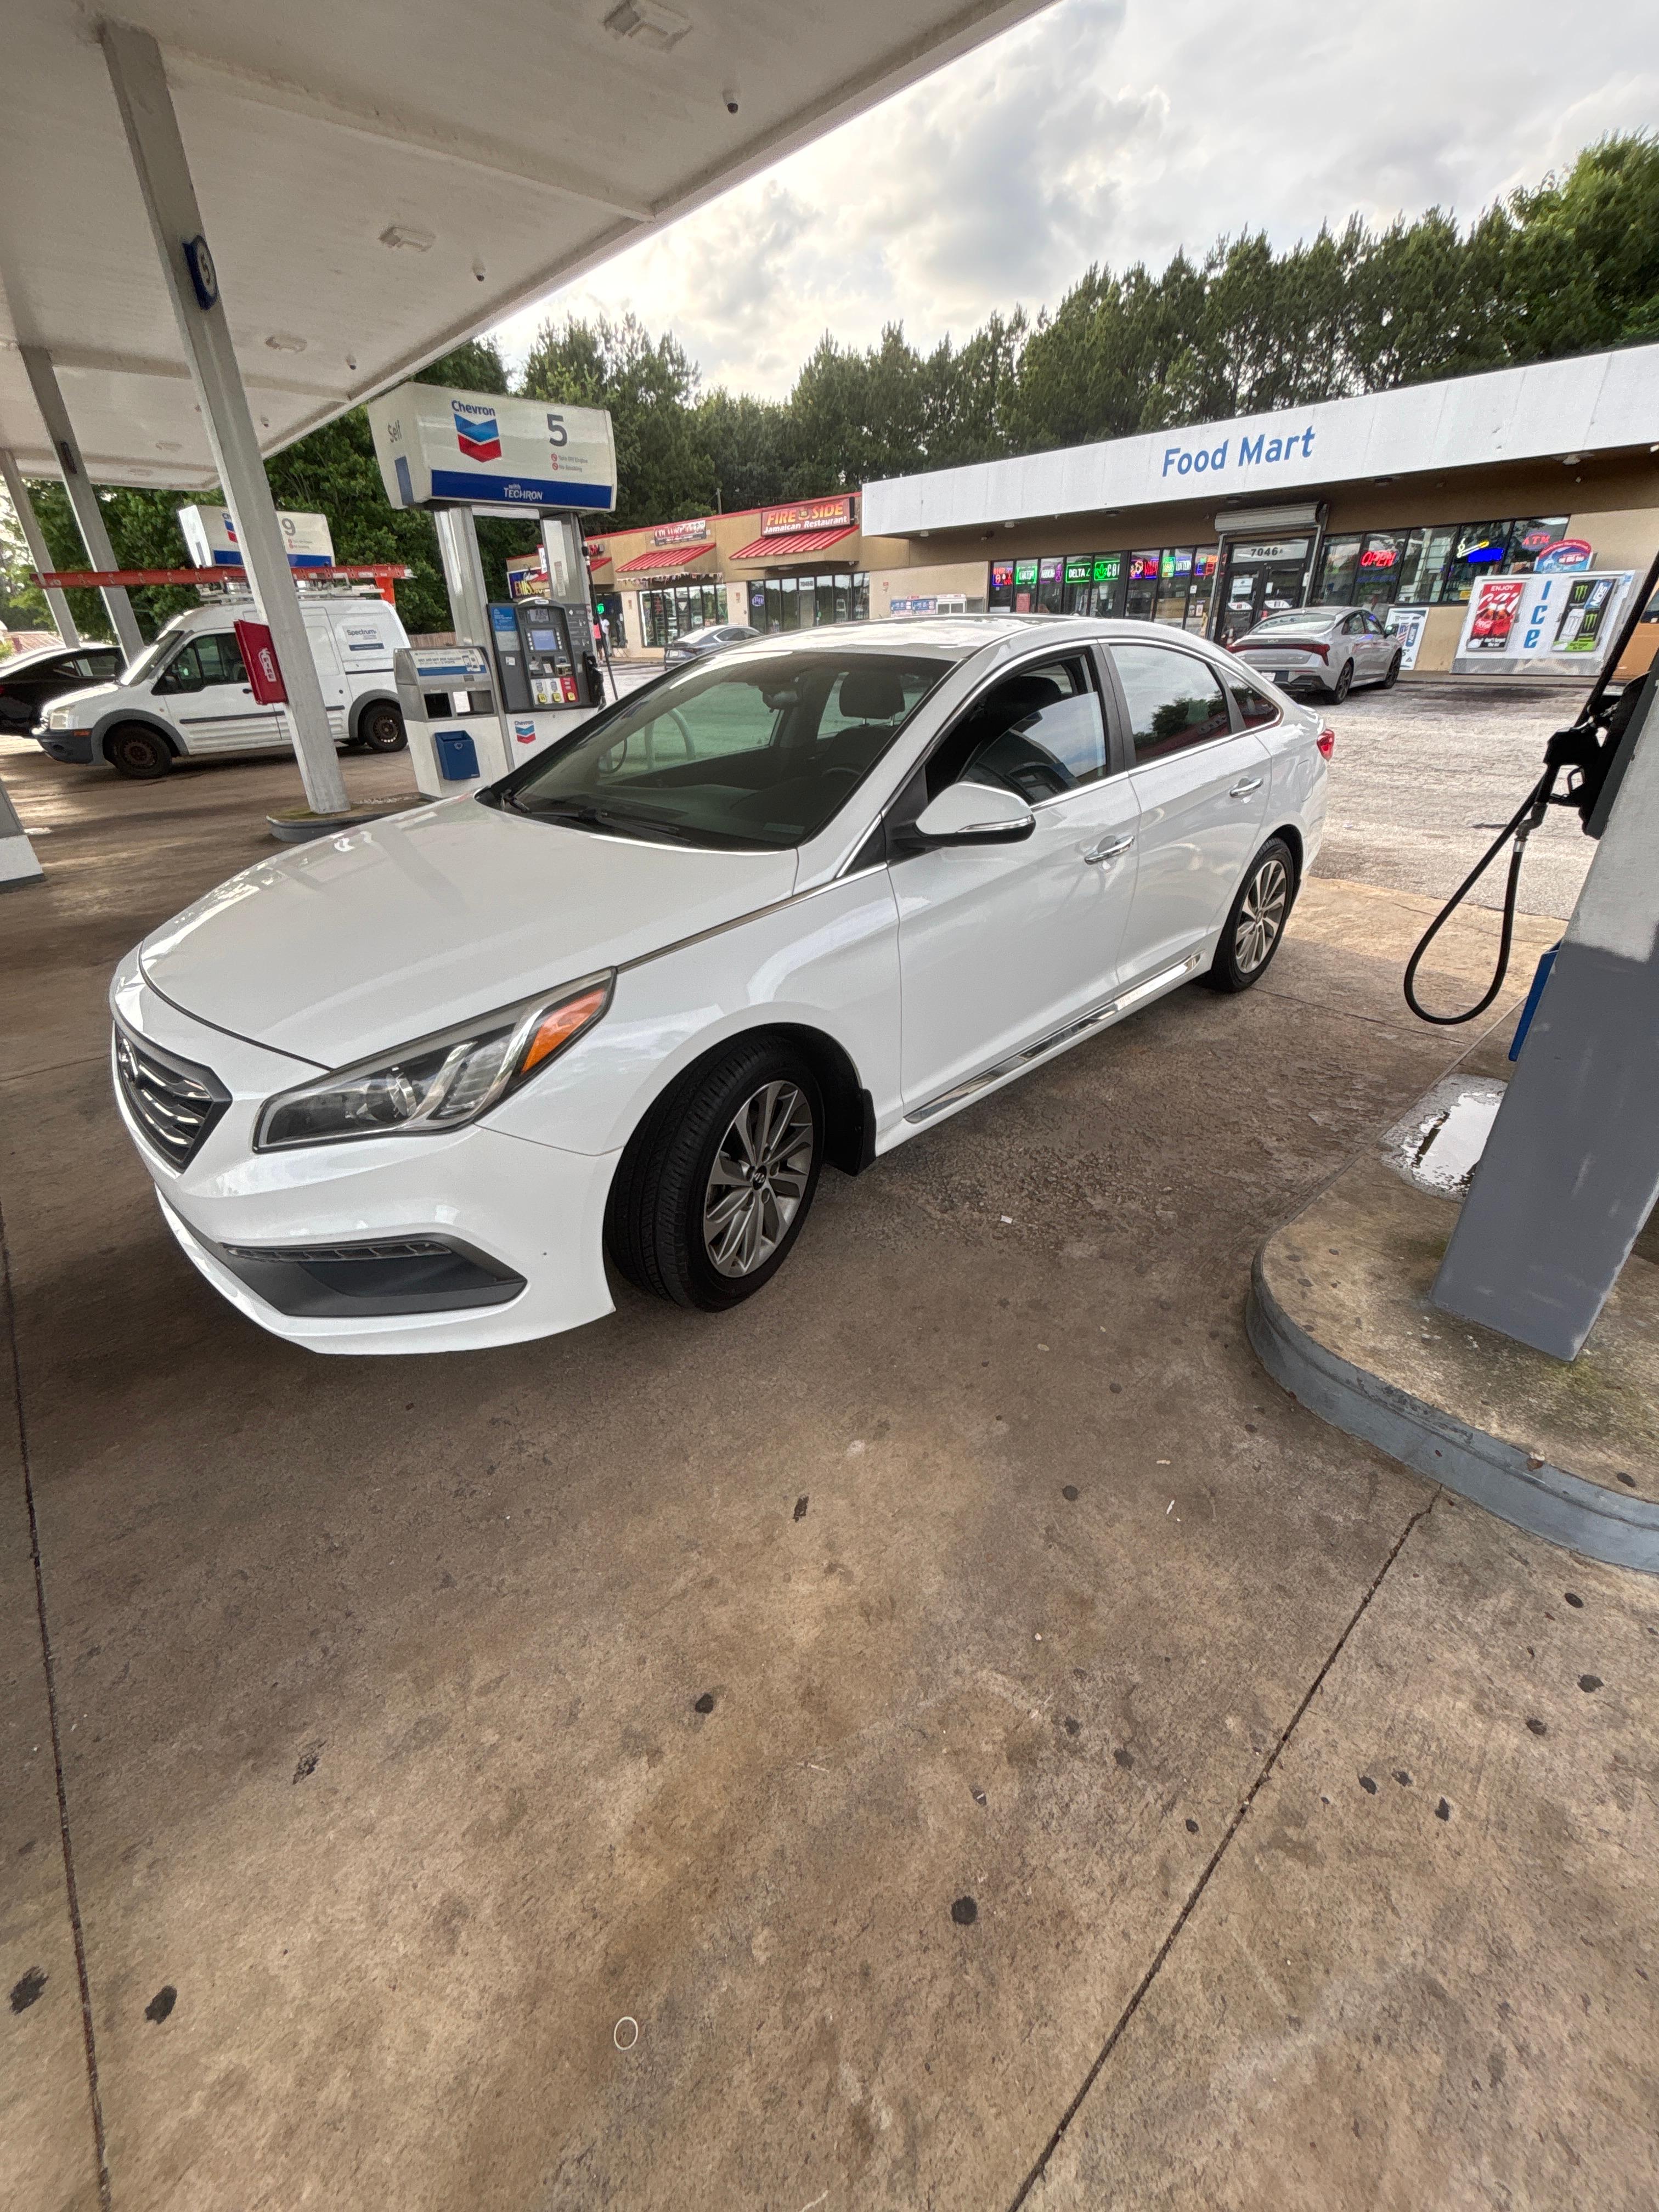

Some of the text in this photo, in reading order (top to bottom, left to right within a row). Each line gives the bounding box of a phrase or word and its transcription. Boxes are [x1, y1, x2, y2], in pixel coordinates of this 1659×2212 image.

[452, 400, 495, 416] Chevron
[546, 413, 568, 447] 5
[1162, 425, 1316, 477] Food Mart
[503, 487, 543, 501] TECHRON
[767, 501, 844, 526] FIRE SIDE
[281, 517, 296, 536] 9
[763, 516, 848, 533] Jamaican Restaurant
[1522, 535, 1550, 545] ATM
[1361, 551, 1397, 567] OPEN
[1069, 568, 1086, 578] DELTA
[1589, 582, 1610, 606] NOS
